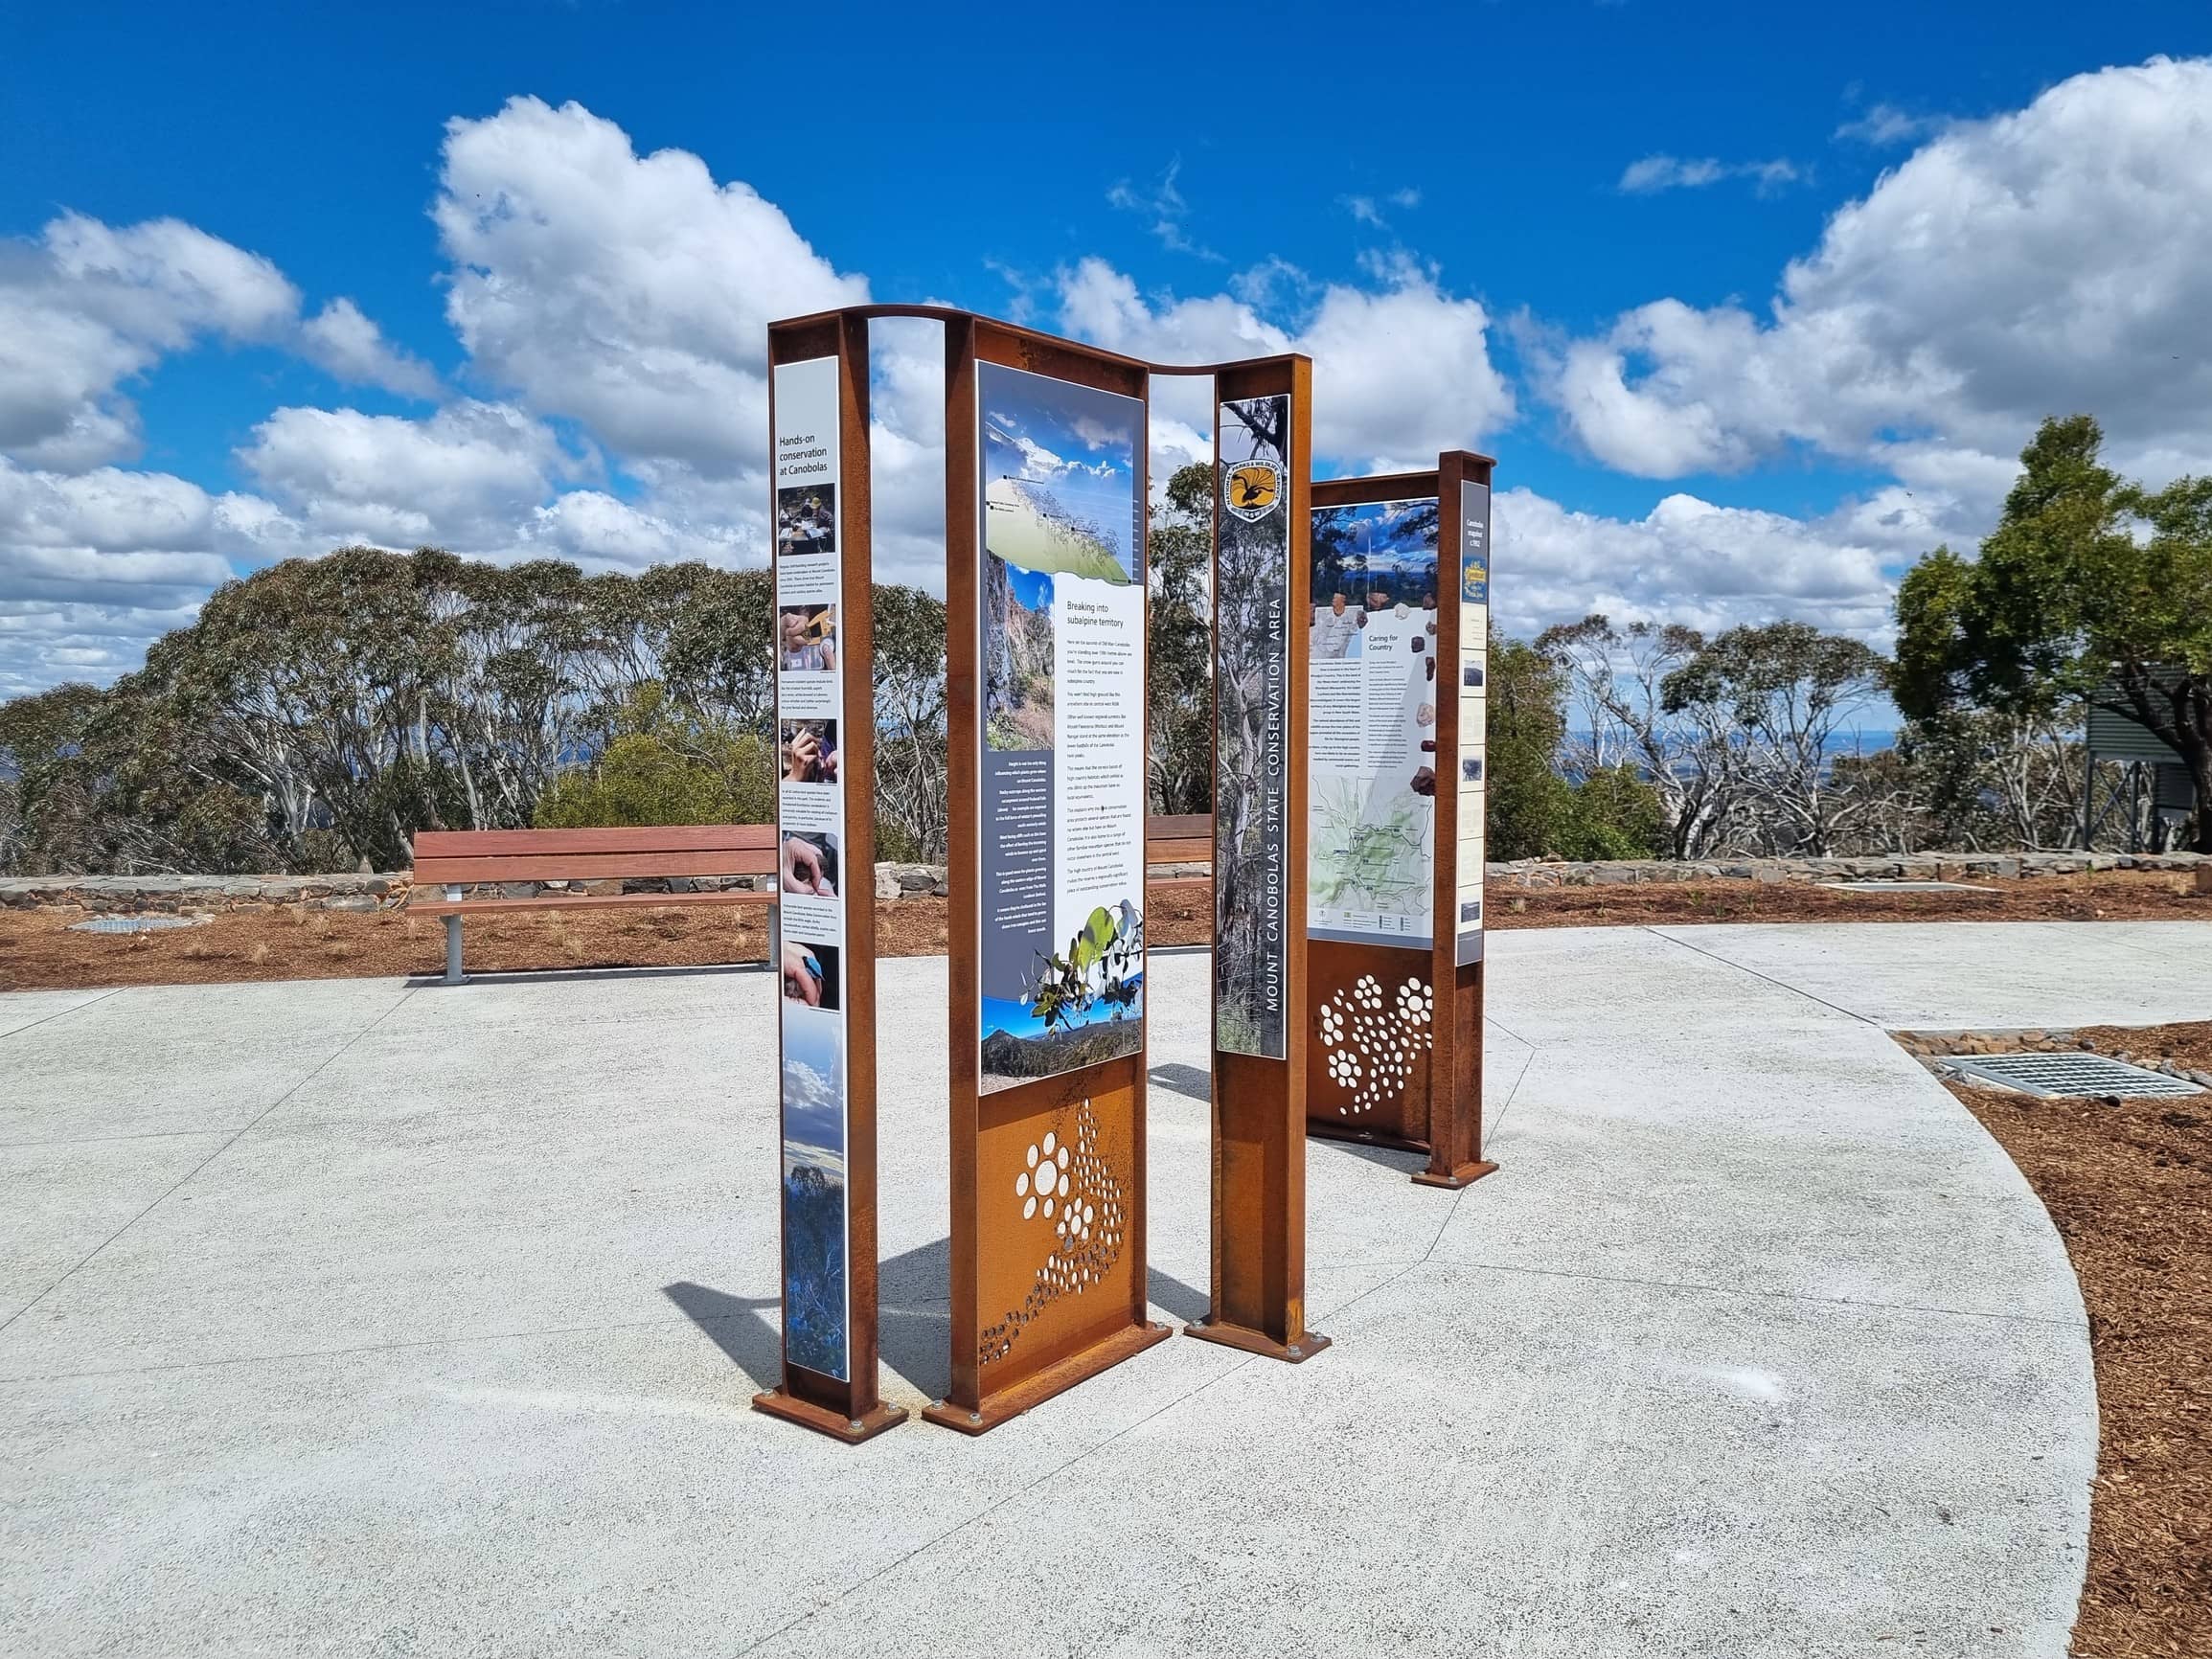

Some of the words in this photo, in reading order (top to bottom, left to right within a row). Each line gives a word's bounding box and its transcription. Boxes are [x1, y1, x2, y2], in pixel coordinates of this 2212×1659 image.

[779, 434, 815, 446] Hands-on
[779, 447, 827, 462] conservation
[779, 466, 787, 476] at
[788, 462, 828, 475] Canobolas
[1067, 601, 1095, 614] Breaking
[1096, 602, 1108, 613] into
[1067, 615, 1098, 627] subalpine
[1099, 618, 1124, 628] territory
[1269, 599, 1280, 641] AREA
[1368, 644, 1393, 652] Country
[1267, 652, 1280, 777] CONSERVATION
[1267, 786, 1279, 831] STATE
[1266, 843, 1279, 942] CANOBOLAS
[1266, 953, 1278, 1011] MOUNT
